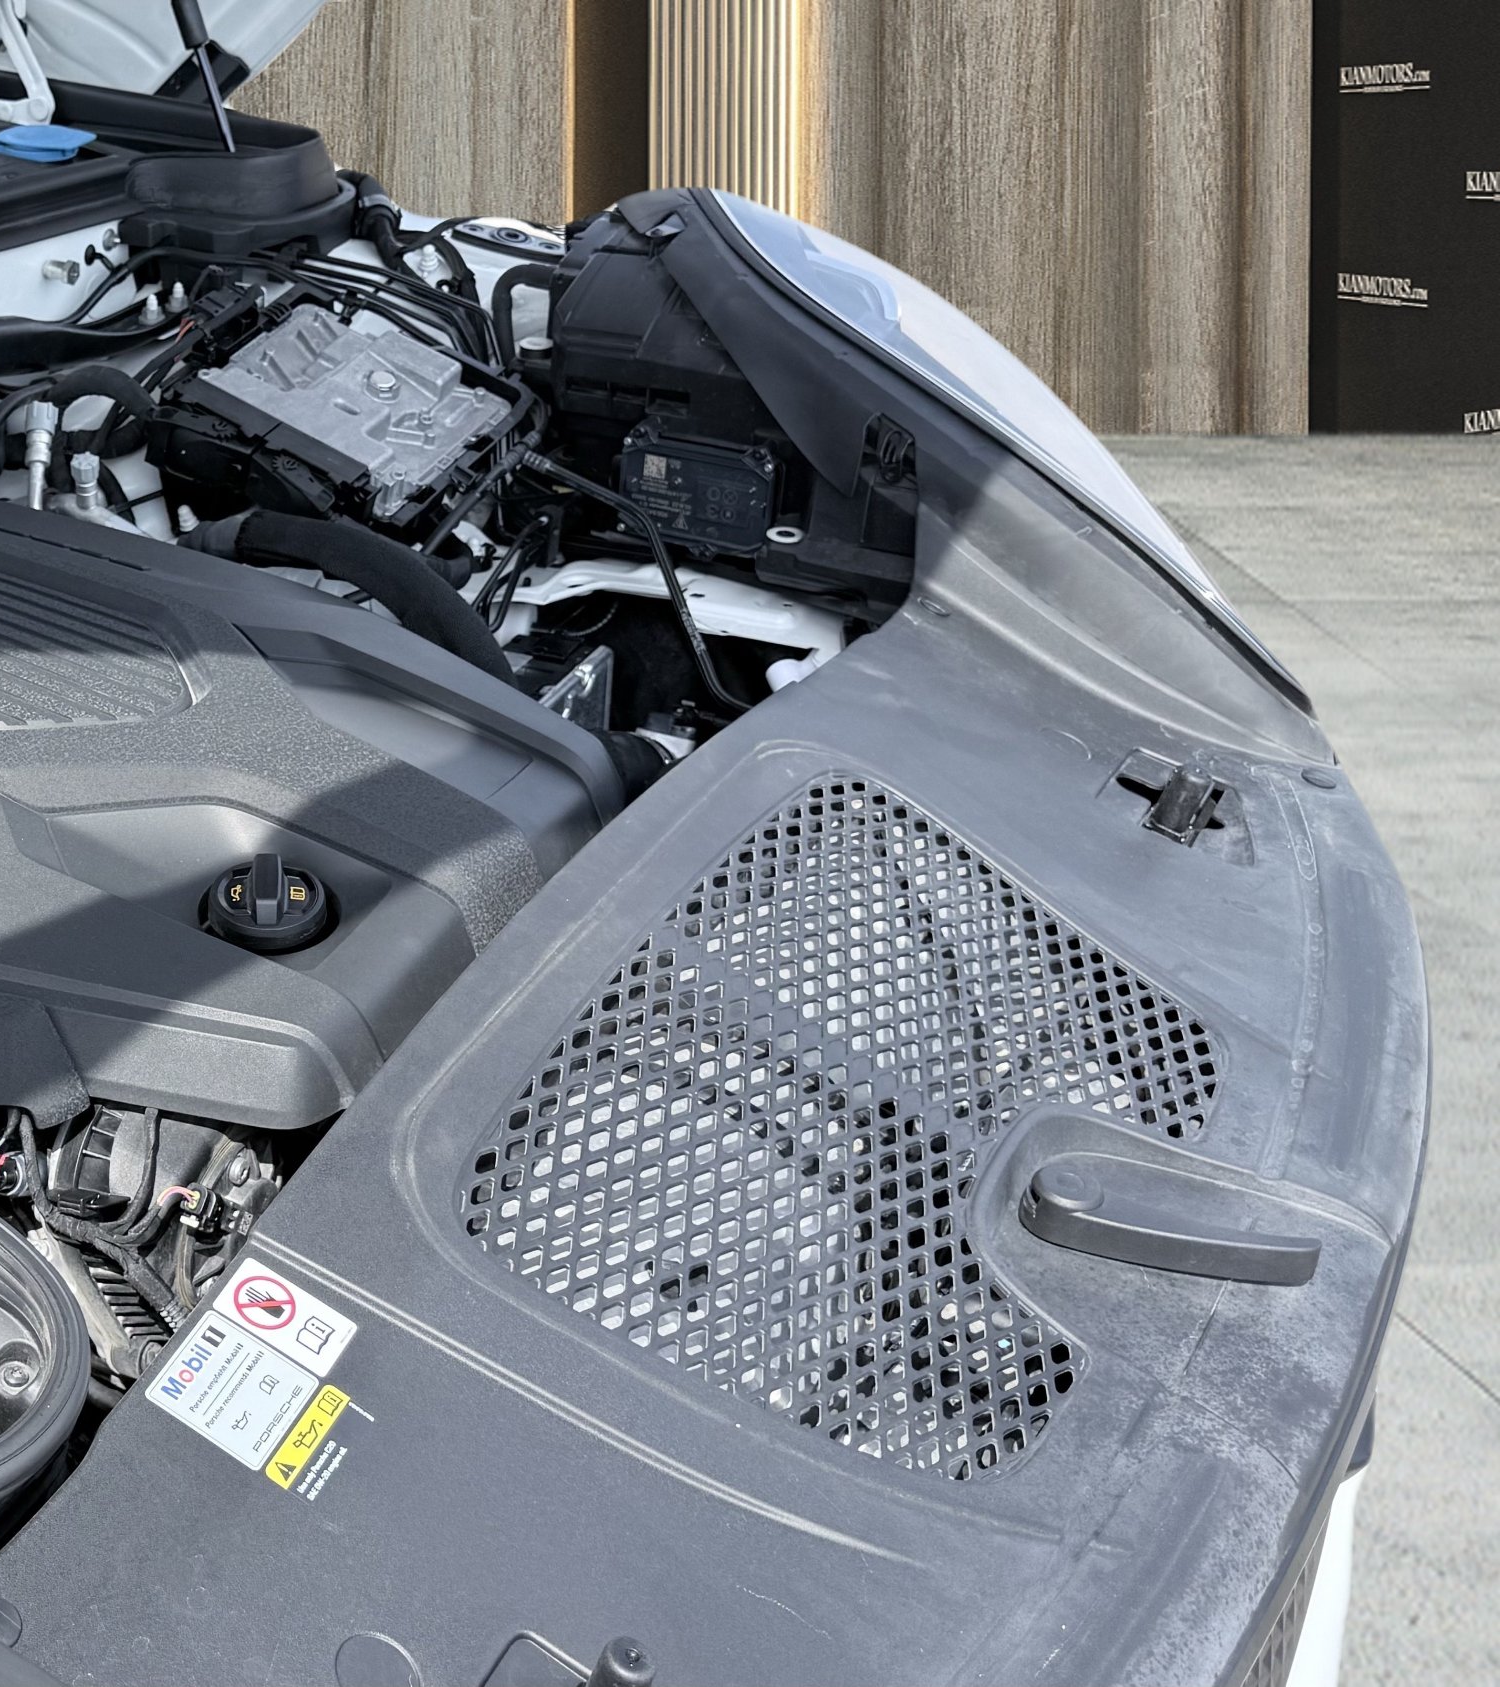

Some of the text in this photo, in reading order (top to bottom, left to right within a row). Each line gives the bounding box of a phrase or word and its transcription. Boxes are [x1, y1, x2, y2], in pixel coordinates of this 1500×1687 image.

[161, 1325, 225, 1399] Mobil 1
[189, 1389, 208, 1412] Porsche
[204, 1405, 224, 1428] Porsche
[252, 1385, 302, 1452] PORSCHE
